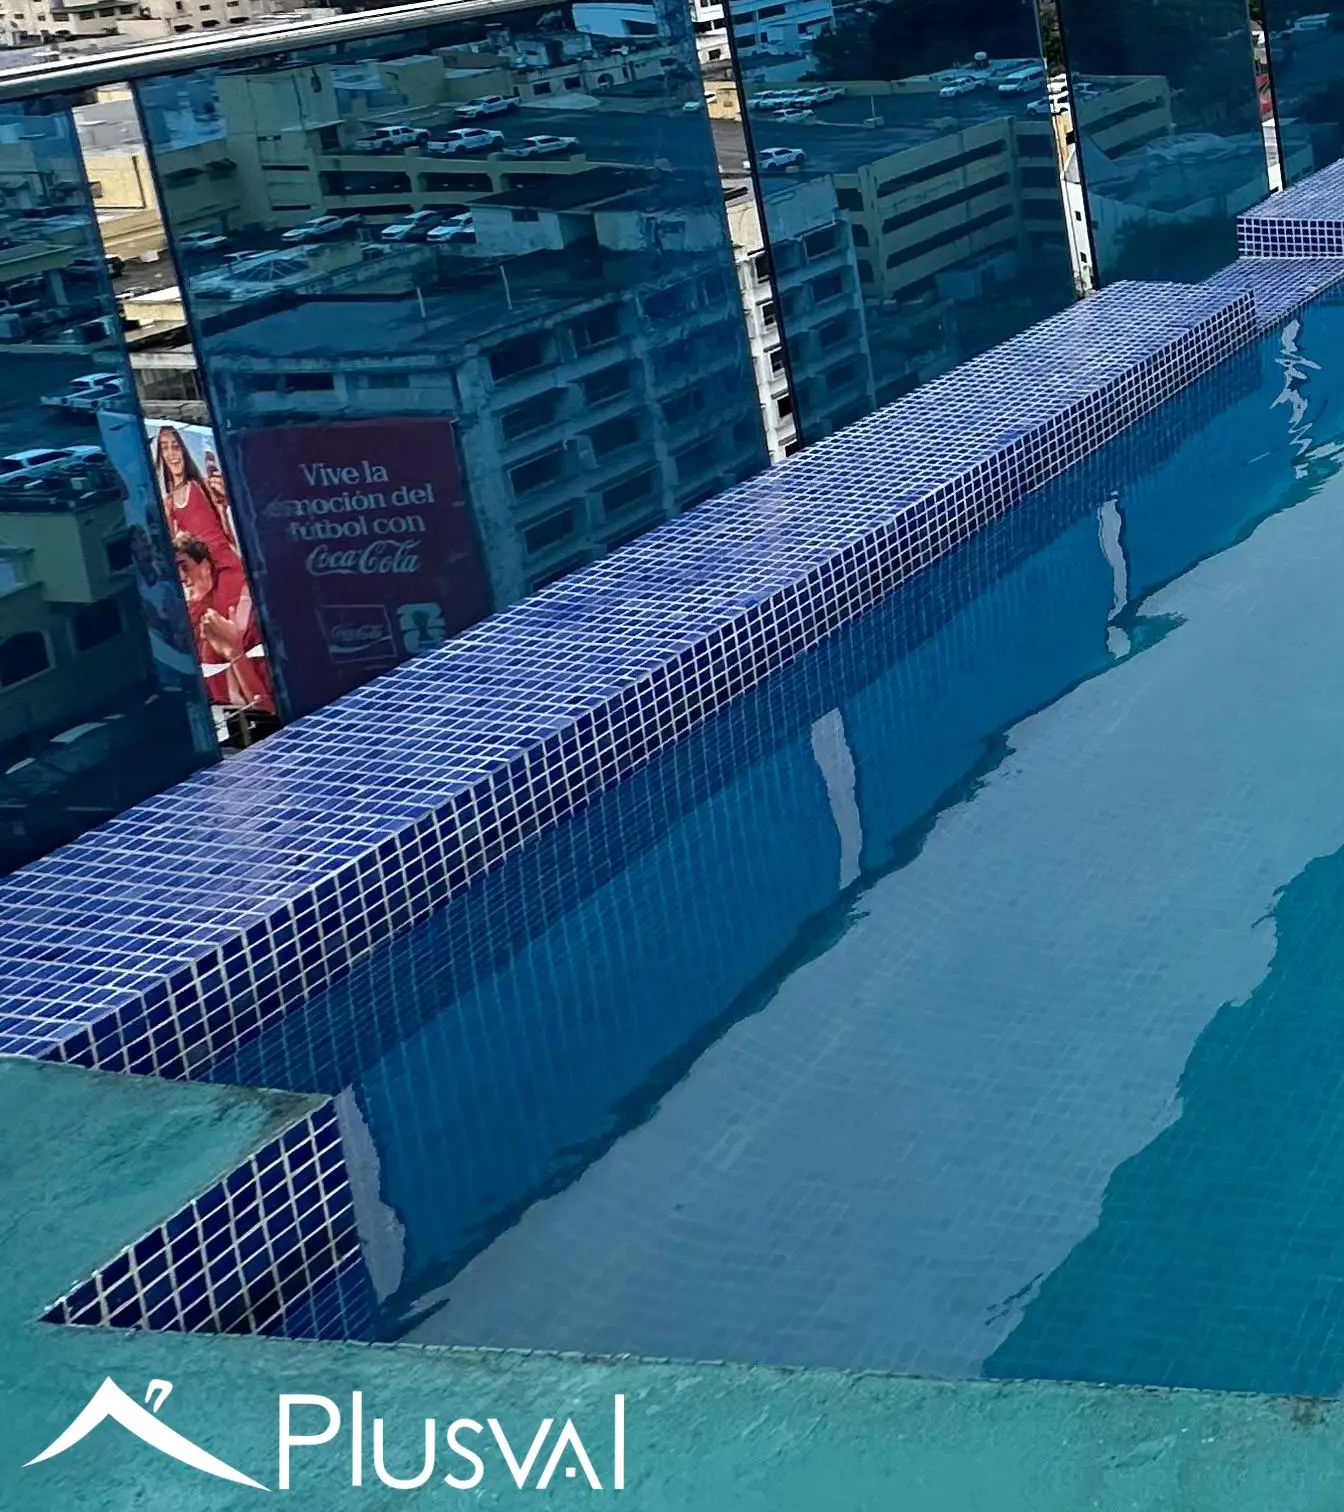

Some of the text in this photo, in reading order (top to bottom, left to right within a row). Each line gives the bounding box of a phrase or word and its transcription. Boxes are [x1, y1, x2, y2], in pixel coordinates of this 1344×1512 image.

[299, 460, 390, 487] Vive la
[391, 483, 436, 506] del
[374, 515, 427, 534] con
[306, 540, 422, 577] Coca-Cola
